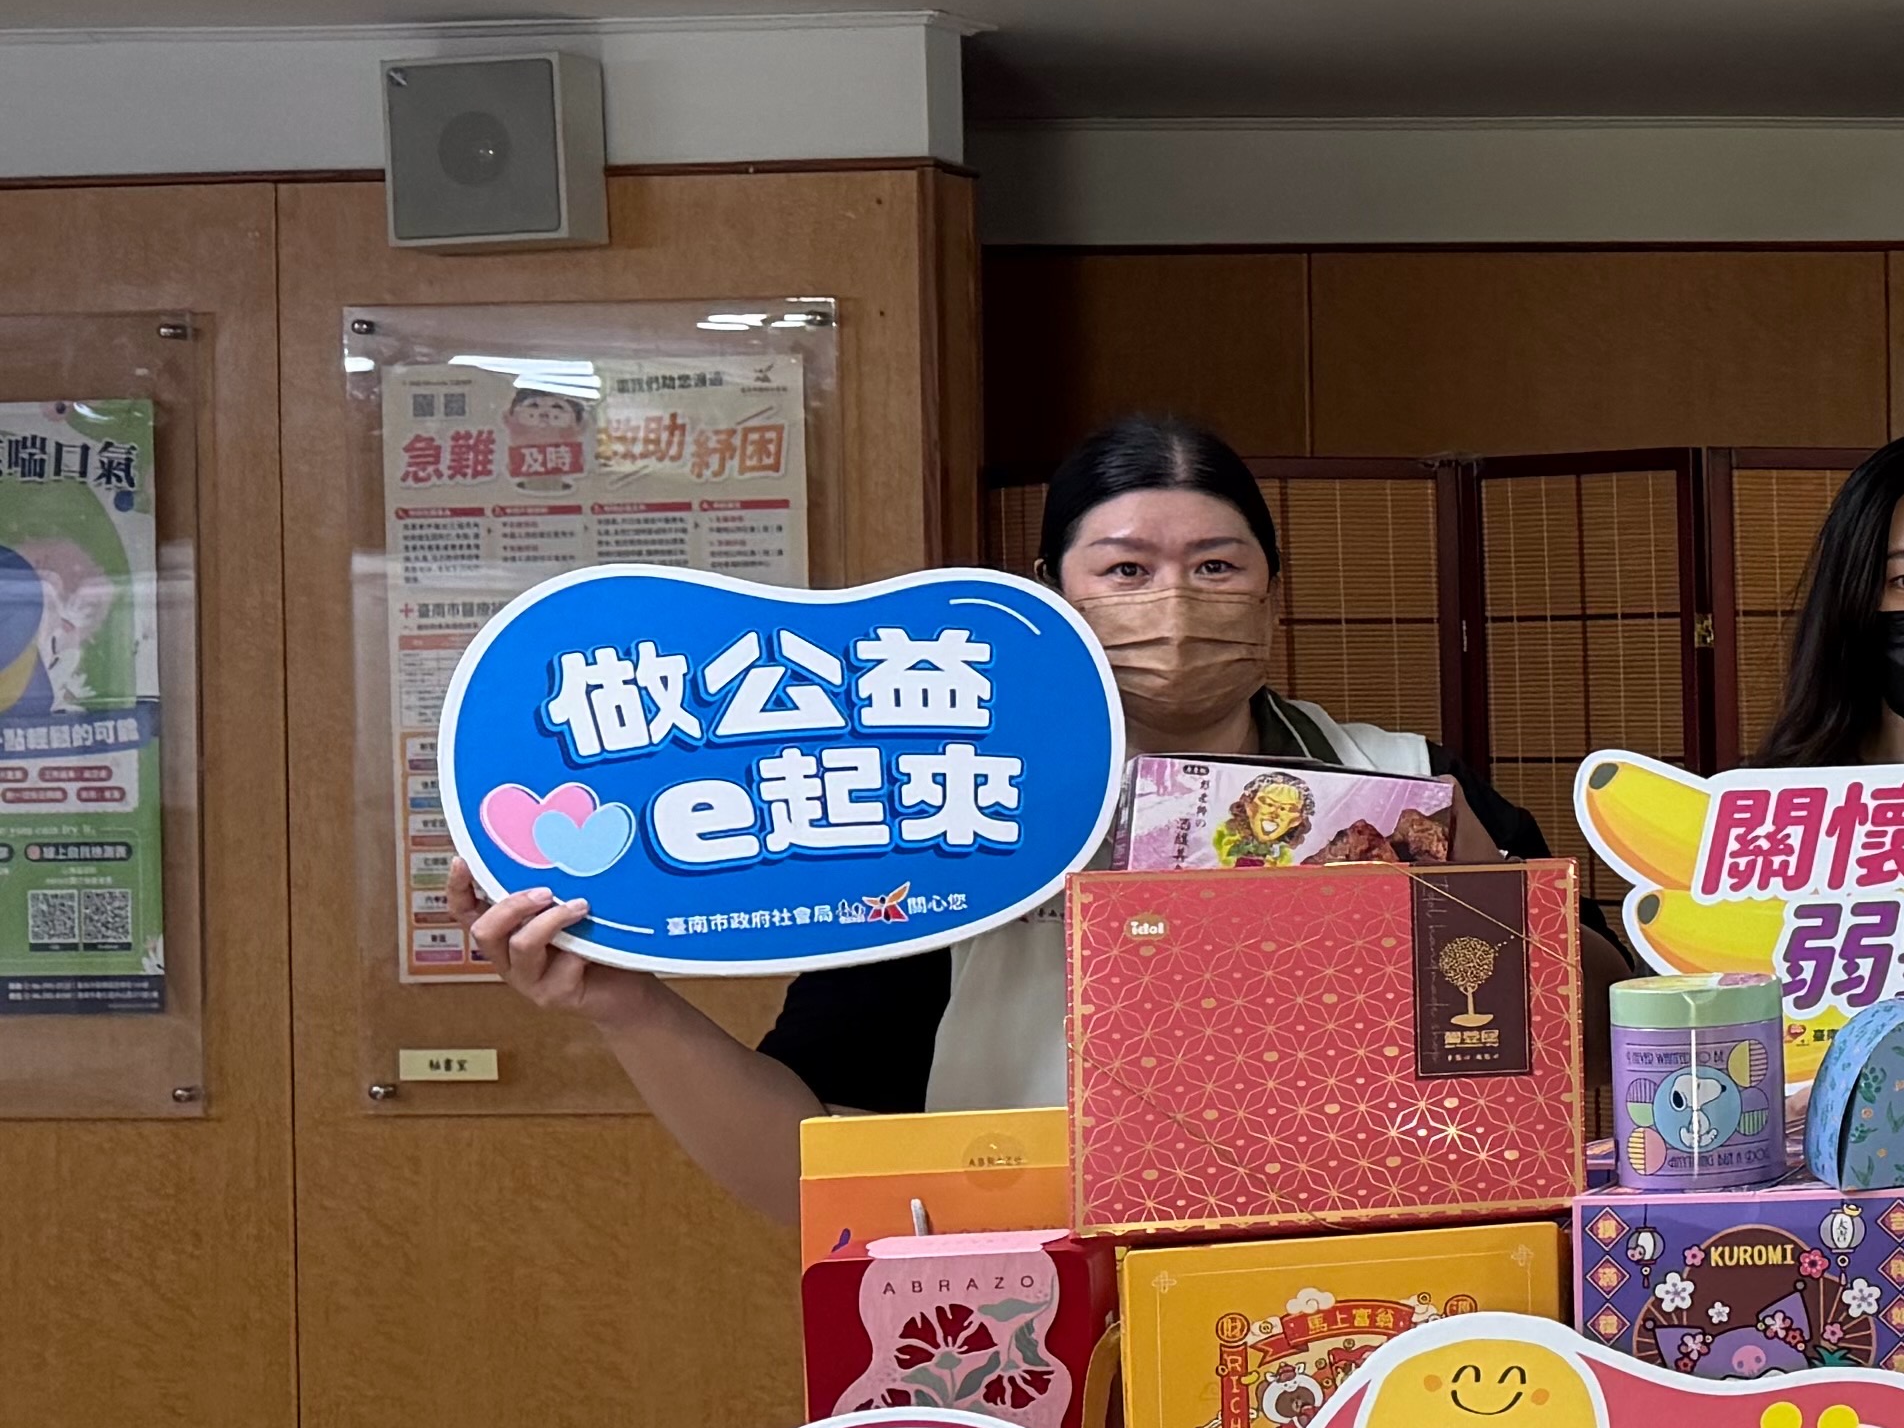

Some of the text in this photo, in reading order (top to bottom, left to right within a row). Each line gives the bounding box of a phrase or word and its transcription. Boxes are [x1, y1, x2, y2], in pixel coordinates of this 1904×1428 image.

[0, 434, 138, 489] 喘口氣
[402, 413, 785, 482] 急難 及時 救助 紓困
[548, 626, 993, 759] 做公益
[653, 743, 1023, 863] e起來
[666, 893, 968, 937] 臺南市政府社會局 關心您
[1131, 921, 1164, 935] idol
[1709, 1242, 1798, 1269] KUROMI
[882, 1274, 1035, 1296] ABRAZO
[1307, 1308, 1395, 1334] 馬上富翁
